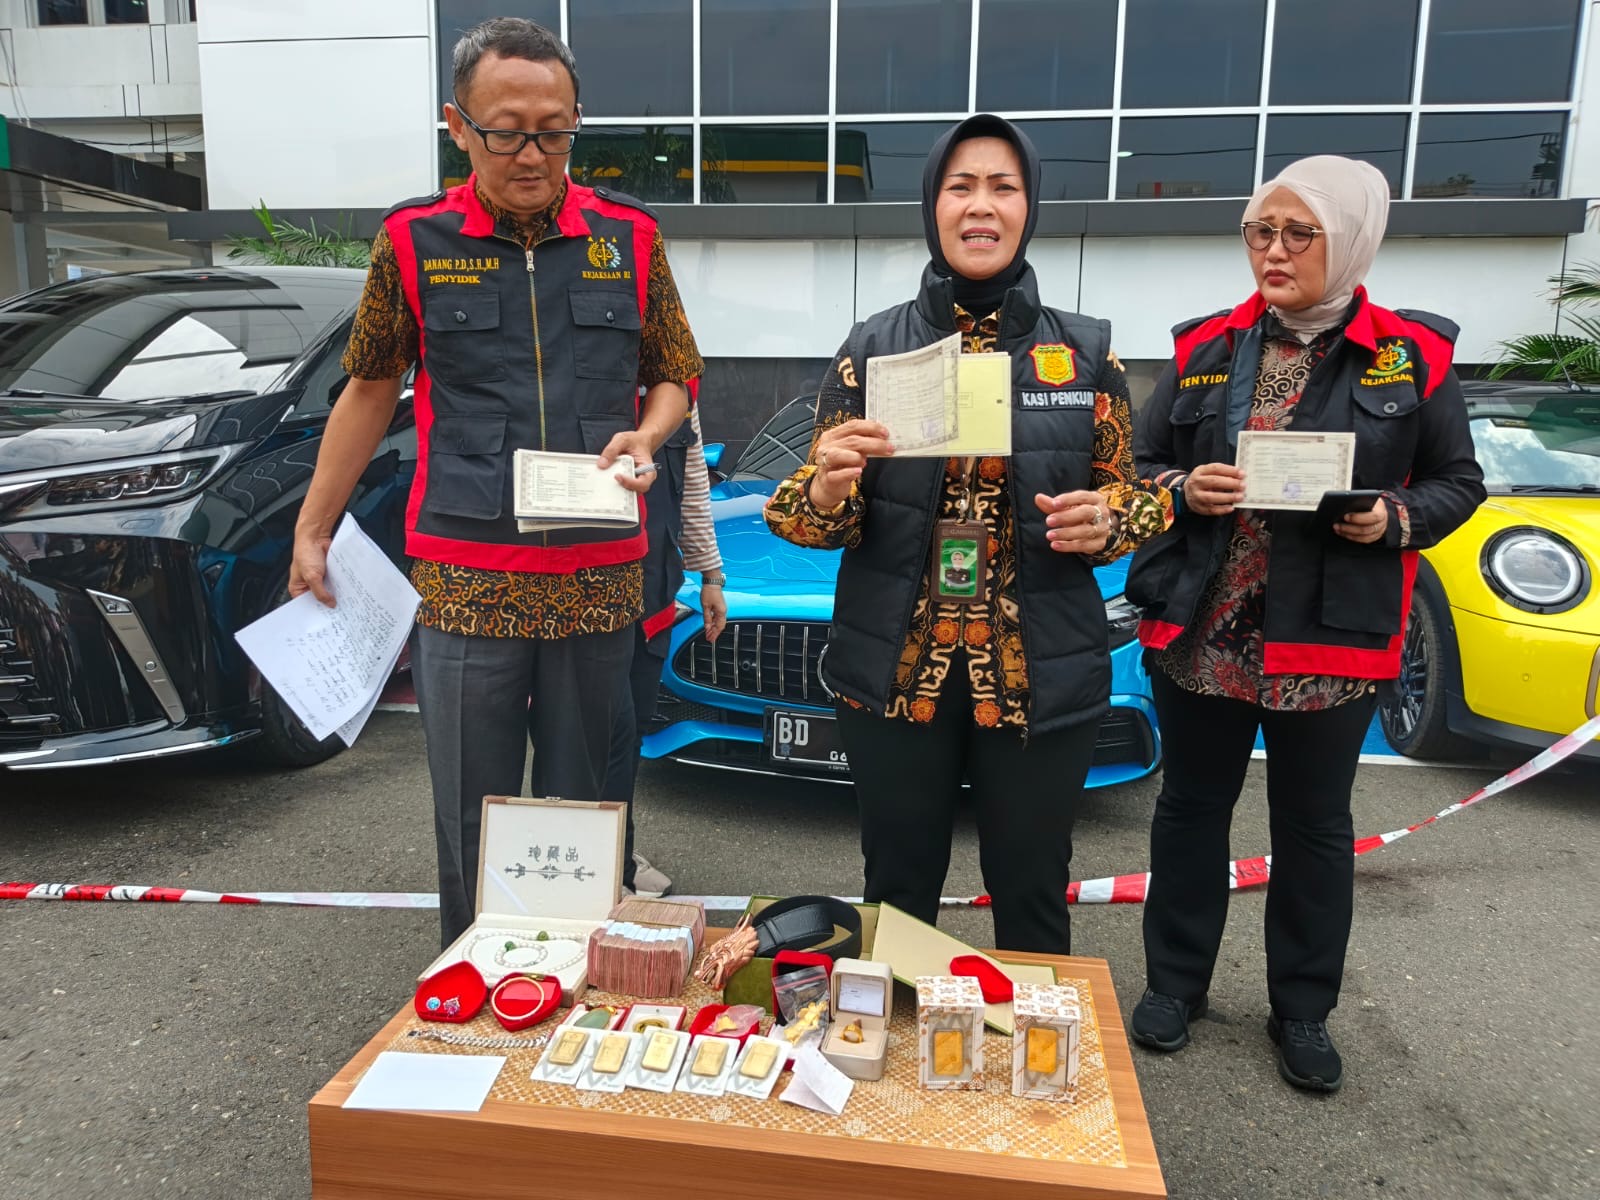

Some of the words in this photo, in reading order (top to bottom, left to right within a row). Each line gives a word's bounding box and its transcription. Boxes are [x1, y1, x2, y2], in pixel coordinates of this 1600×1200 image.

[423, 258, 453, 272] DANANG
[429, 274, 481, 285] PENYIDIK
[582, 270, 621, 280] KEJAKSAAN
[1179, 374, 1229, 390] PENYIDI
[1021, 391, 1049, 407] KASI
[779, 717, 809, 746] BD
